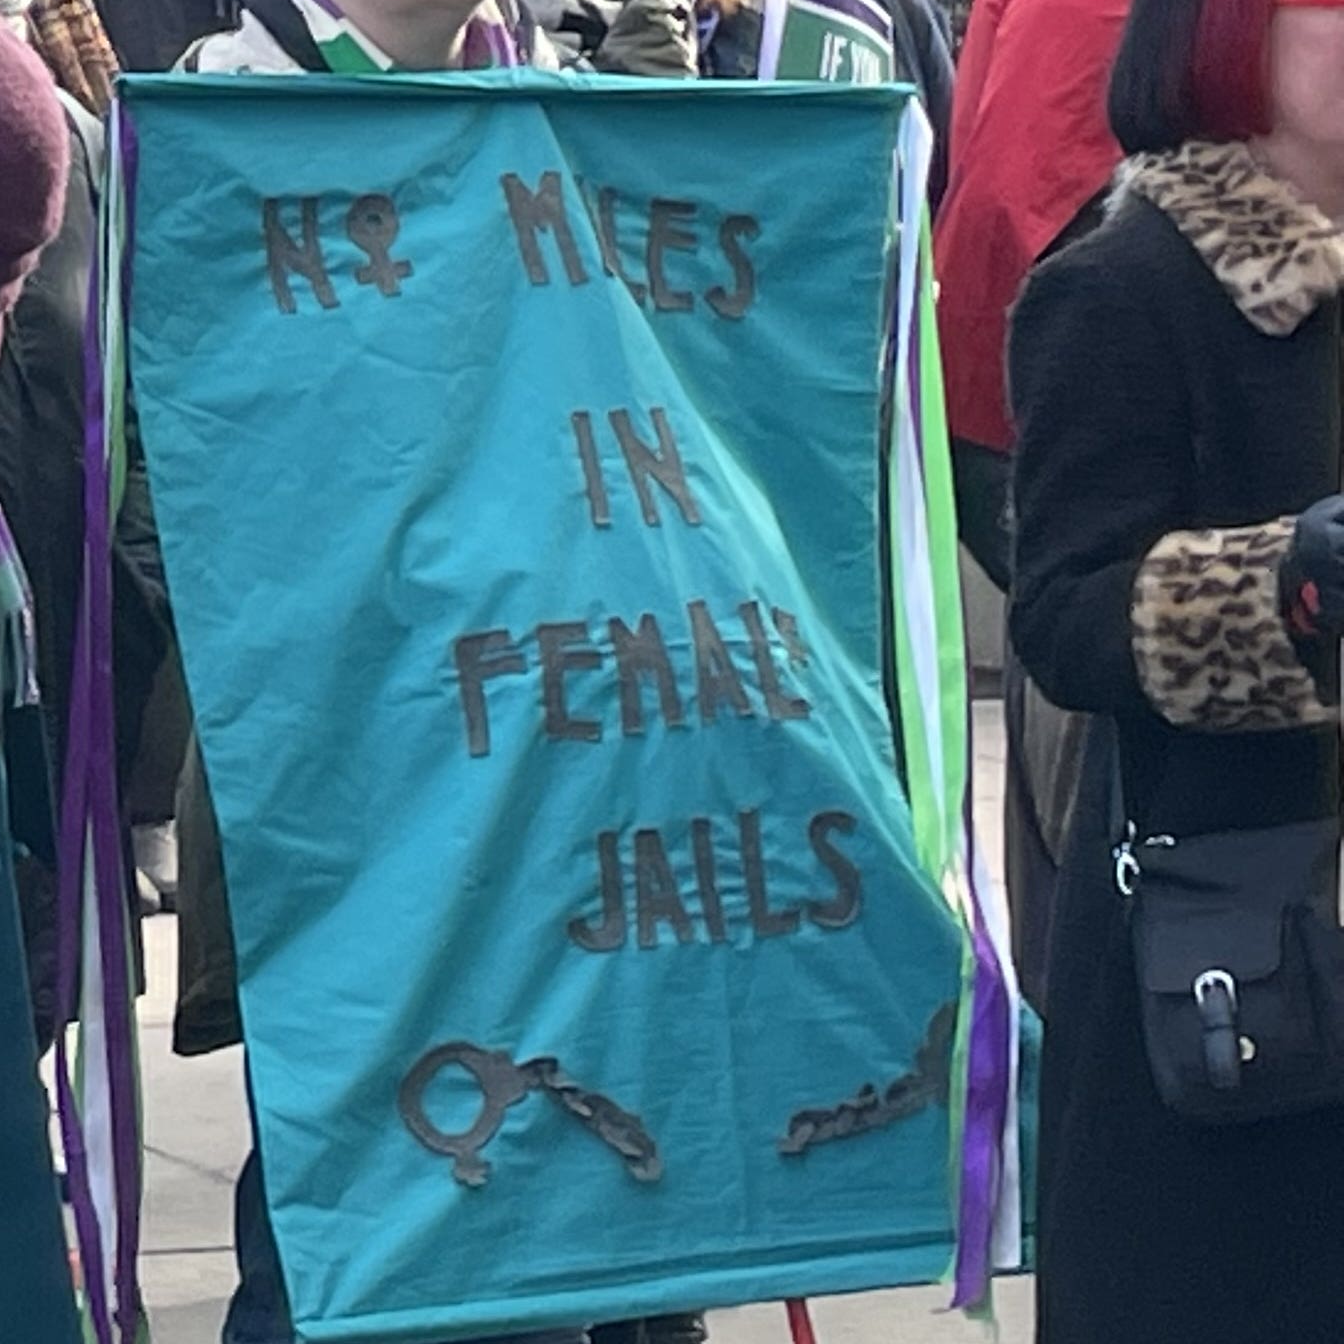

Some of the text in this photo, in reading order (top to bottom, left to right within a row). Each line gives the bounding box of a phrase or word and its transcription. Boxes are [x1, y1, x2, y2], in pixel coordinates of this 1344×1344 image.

[819, 31, 849, 82] IF
[500, 170, 761, 322] MLES
[573, 408, 700, 530] IN
[568, 806, 861, 952] JAILS
